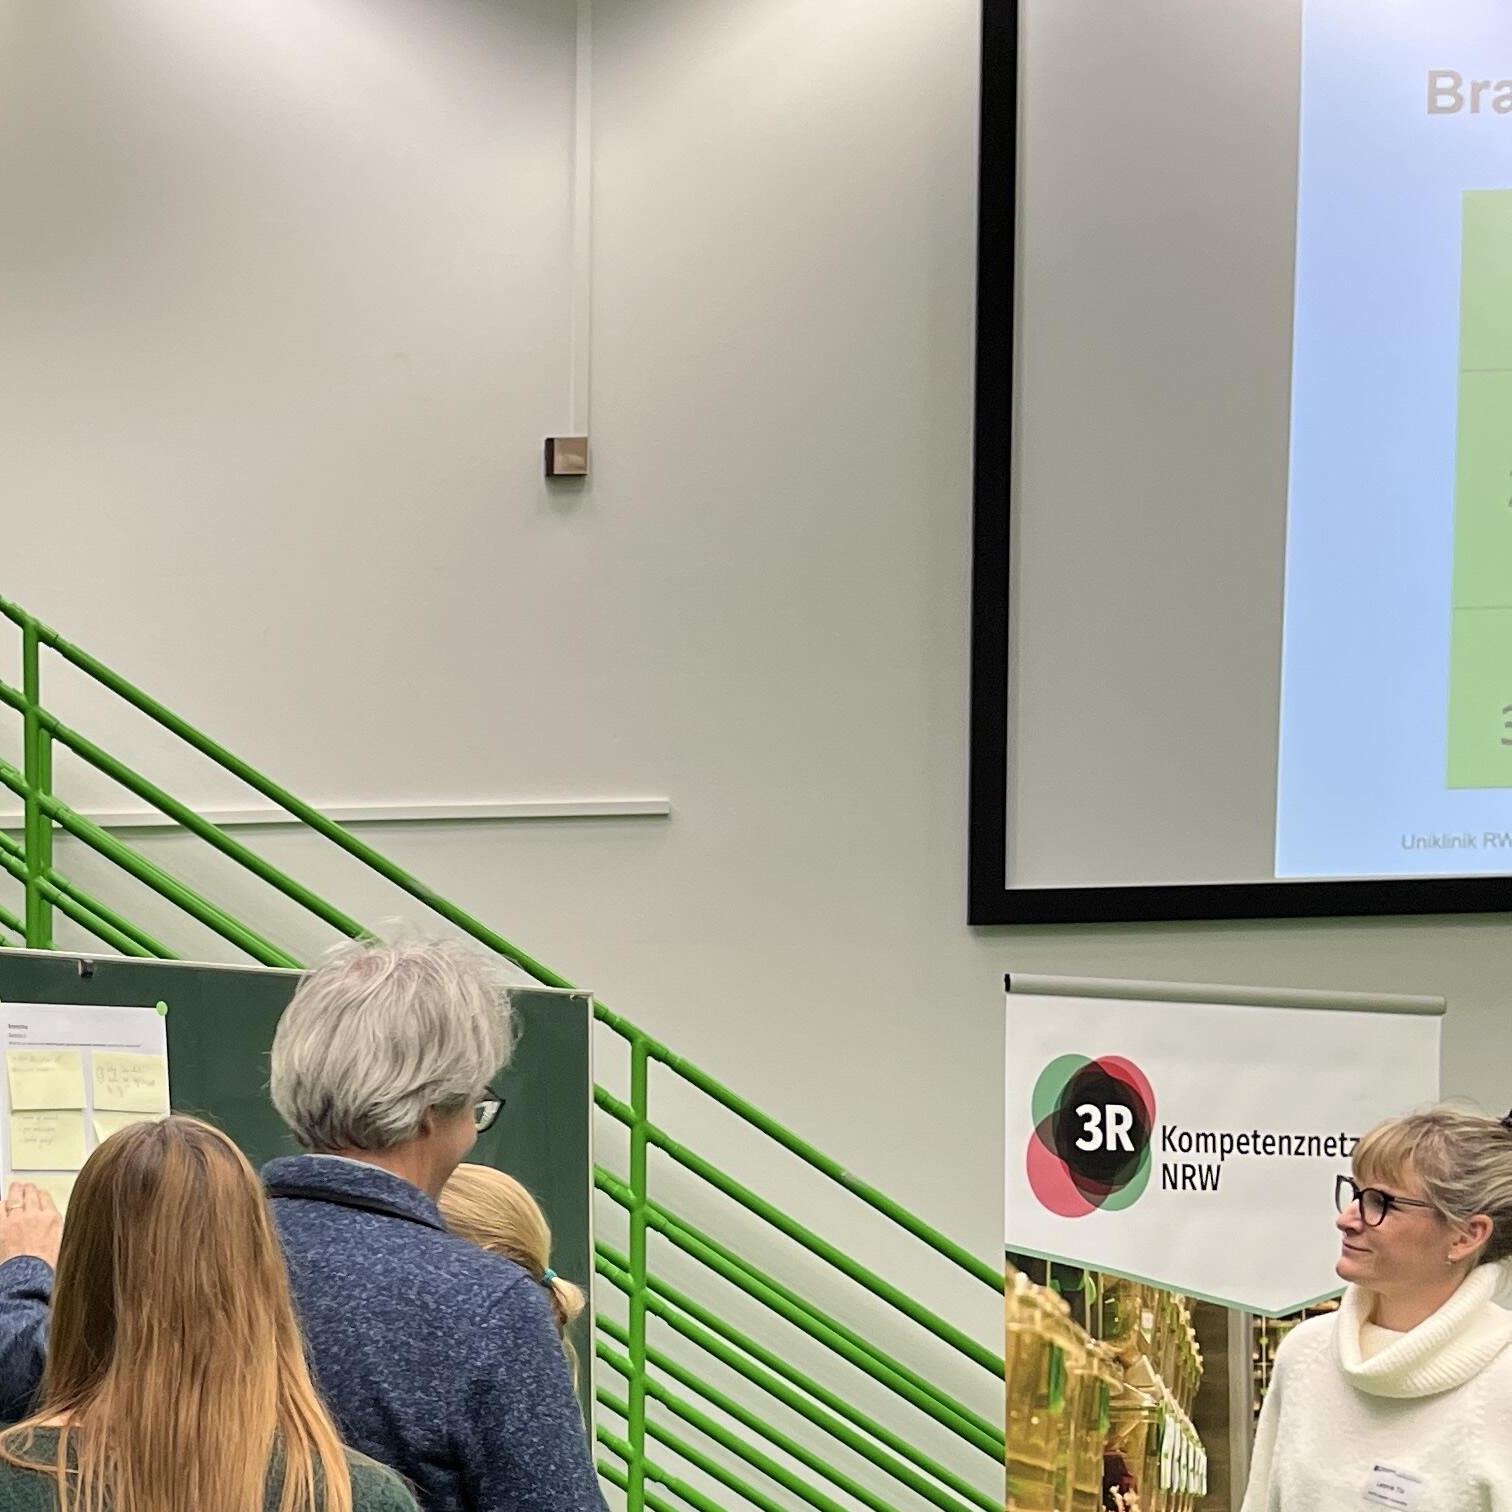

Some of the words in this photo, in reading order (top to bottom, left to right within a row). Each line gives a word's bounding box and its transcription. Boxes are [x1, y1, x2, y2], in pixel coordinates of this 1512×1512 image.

[1427, 69, 1512, 115] Bra
[1401, 833, 1477, 851] Uniklinik
[1483, 832, 1512, 849] RW
[1074, 1103, 1135, 1152] 3R
[1161, 1125, 1360, 1162] Kompetenznetz
[1161, 1162, 1222, 1192] NRW
